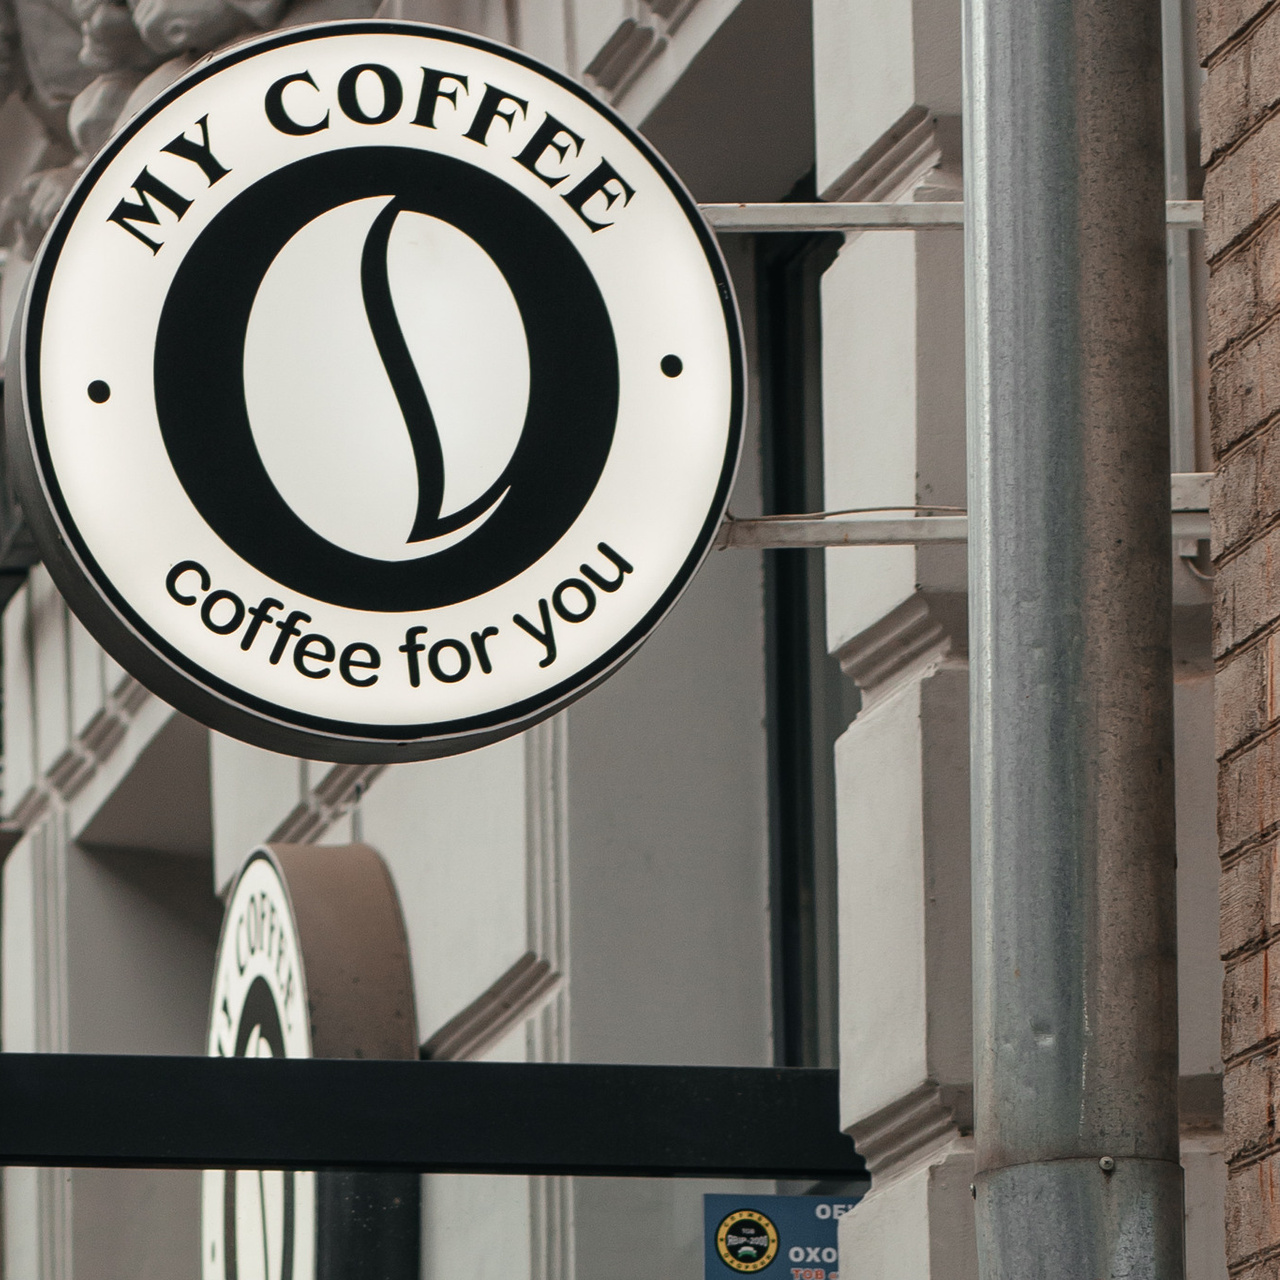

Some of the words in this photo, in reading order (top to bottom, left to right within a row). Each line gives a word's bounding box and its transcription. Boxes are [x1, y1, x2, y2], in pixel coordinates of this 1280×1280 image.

[106, 113, 232, 256] MY
[264, 62, 636, 234] COFFEE
[166, 560, 381, 688] coffee
[399, 626, 499, 688] for
[513, 541, 635, 669] you
[788, 1247, 838, 1263] ОХО
[791, 1268, 825, 1280] ТОВ
